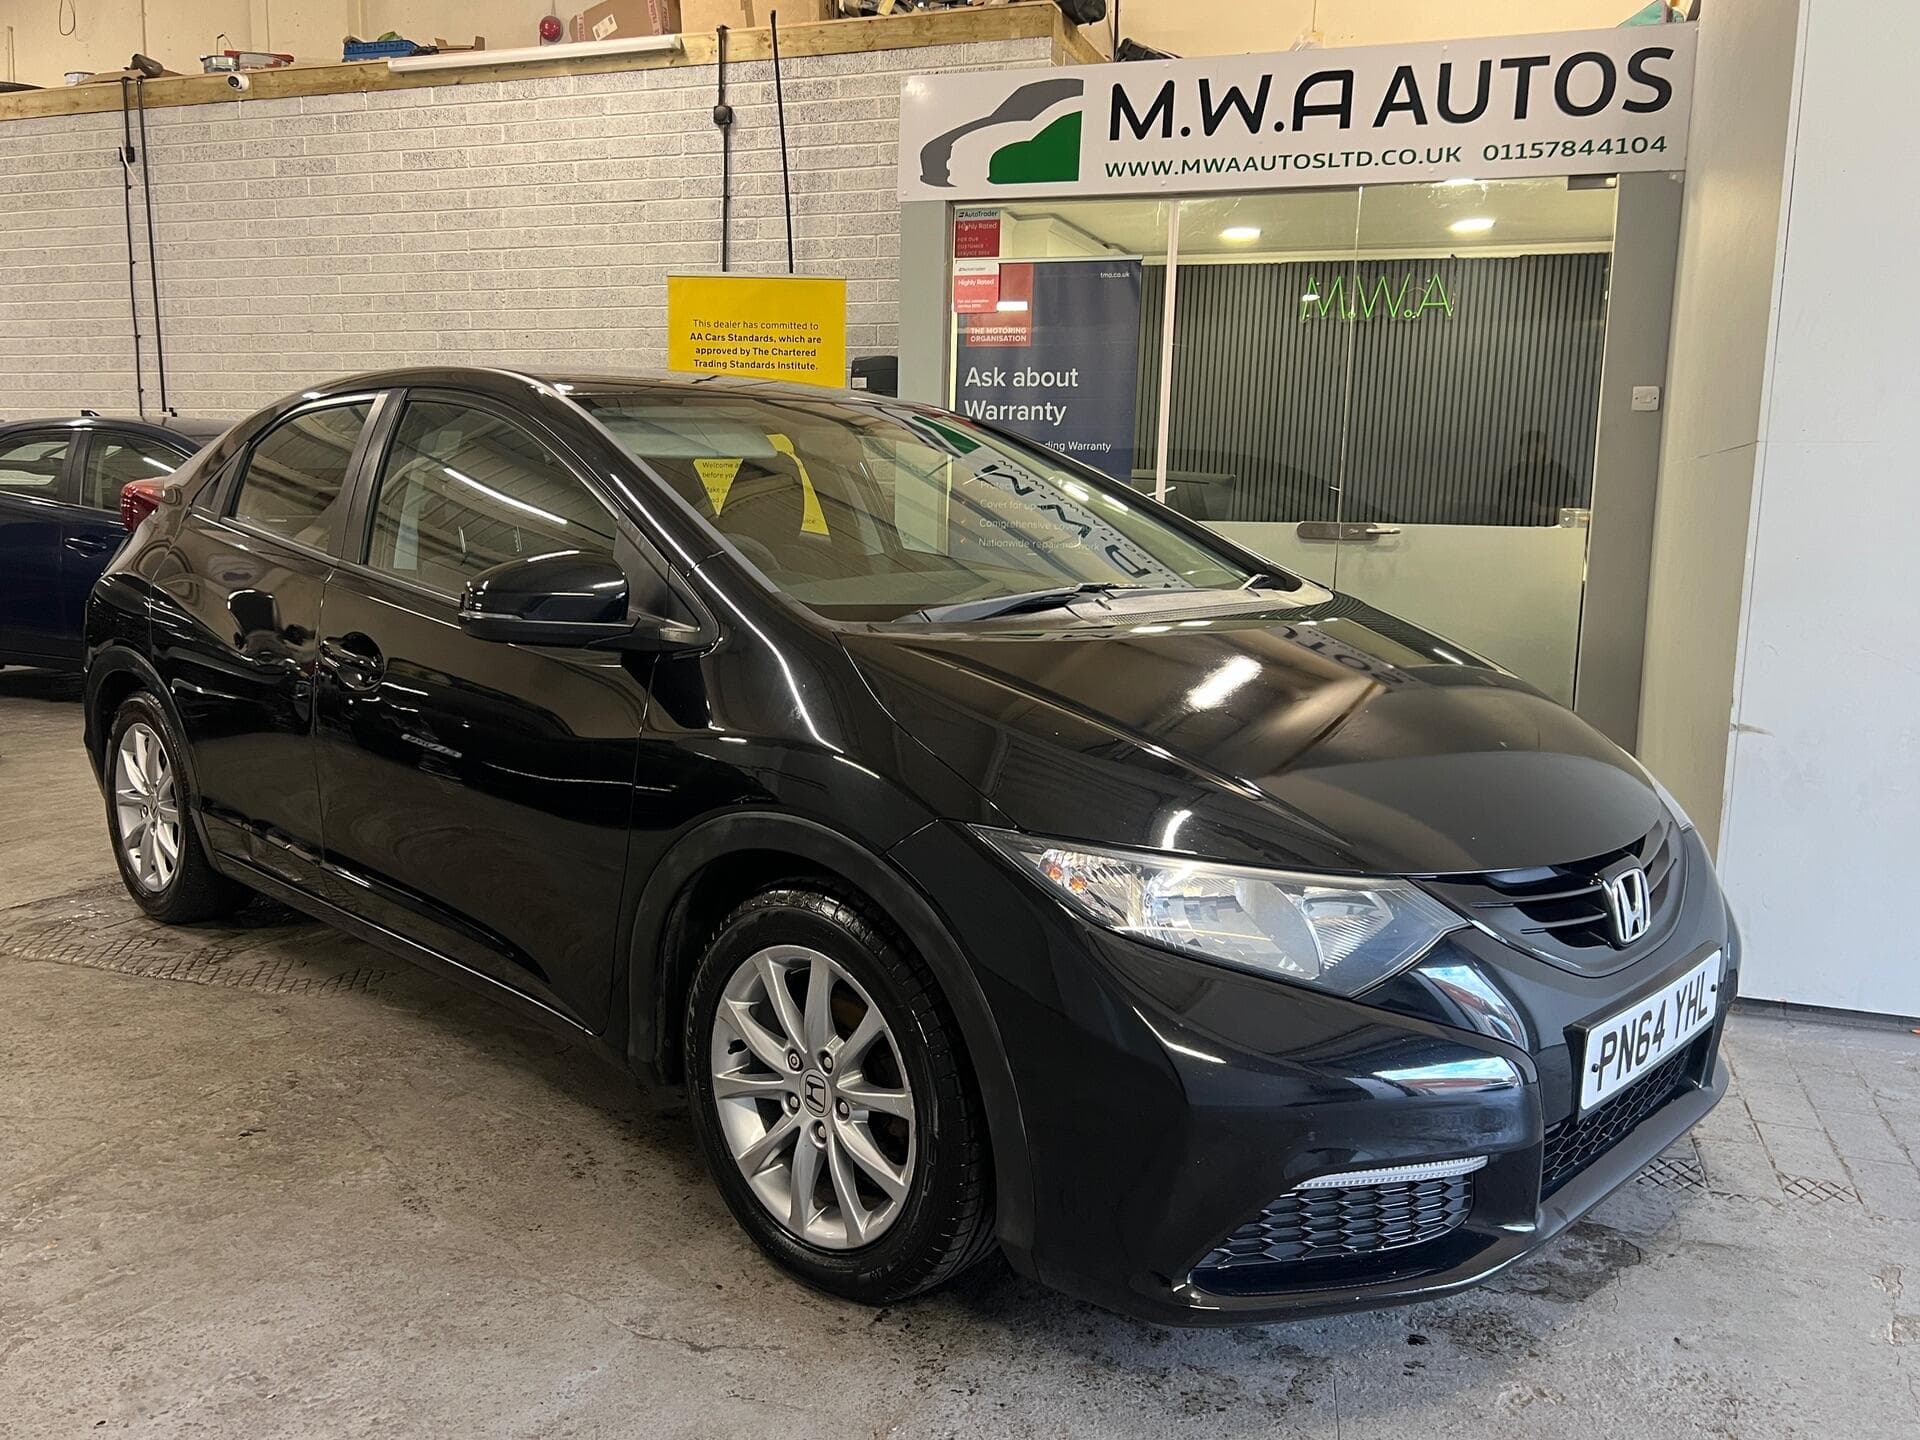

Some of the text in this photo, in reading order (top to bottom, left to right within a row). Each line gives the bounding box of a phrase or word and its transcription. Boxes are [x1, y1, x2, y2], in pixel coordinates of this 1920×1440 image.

[1372, 47, 1675, 128] AUTOS
[1105, 136, 1667, 177] WWW.MWAAUTOSLTD.CO.UK 01157844104
[693, 319, 819, 331] This dealer has committed to
[970, 326, 1027, 335] THE MOTORING
[690, 332, 703, 341] AA
[705, 333, 726, 342] Cars
[779, 335, 805, 343] which
[807, 336, 822, 344] are
[970, 335, 1027, 343] ORGANISATION
[695, 347, 817, 357] approved by The Chartered
[694, 359, 818, 371] Trading Standards Institute.
[964, 366, 1079, 387] Ask about
[964, 400, 1067, 427] Warranty
[1068, 440, 1112, 454] Warranty
[979, 518, 1052, 530] Comprehensive
[978, 537, 1030, 549] Nationwide
[1596, 971, 1708, 1092] PN64 YHL
